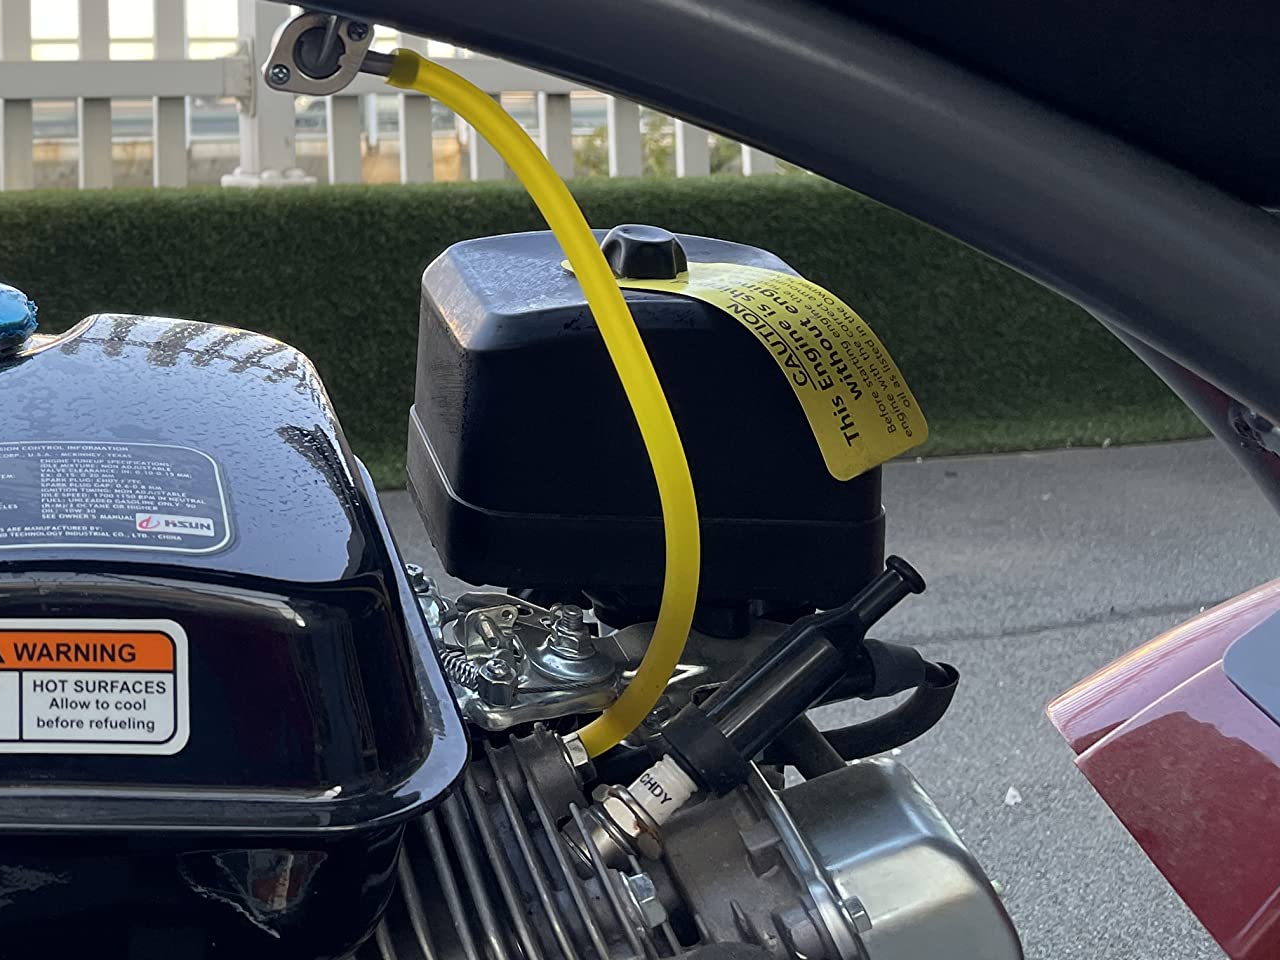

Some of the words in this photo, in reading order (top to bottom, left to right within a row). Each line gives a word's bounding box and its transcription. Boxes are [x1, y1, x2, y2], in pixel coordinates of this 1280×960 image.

[757, 303, 777, 318] is
[804, 304, 841, 338] engine
[816, 302, 854, 338] correct
[836, 306, 855, 324] the
[726, 303, 808, 387] CAUTION
[855, 325, 867, 337] in
[778, 320, 834, 390] Engine
[799, 318, 863, 401] without
[840, 340, 874, 388] starting
[853, 340, 870, 361] the
[864, 339, 891, 373] listed
[868, 363, 888, 391] with
[889, 374, 901, 388] as
[871, 391, 897, 434] Before
[896, 391, 911, 409] oil
[831, 395, 860, 447] This
[886, 393, 913, 438] engine
[13, 643, 137, 663] WARNING
[32, 679, 68, 693] HOT
[74, 680, 166, 694] SURFACES
[49, 697, 90, 711] Allow
[95, 698, 109, 711] to
[115, 698, 146, 711] cool
[36, 716, 84, 729] before
[89, 716, 155, 733] refueling
[639, 773, 672, 805] CHDY
